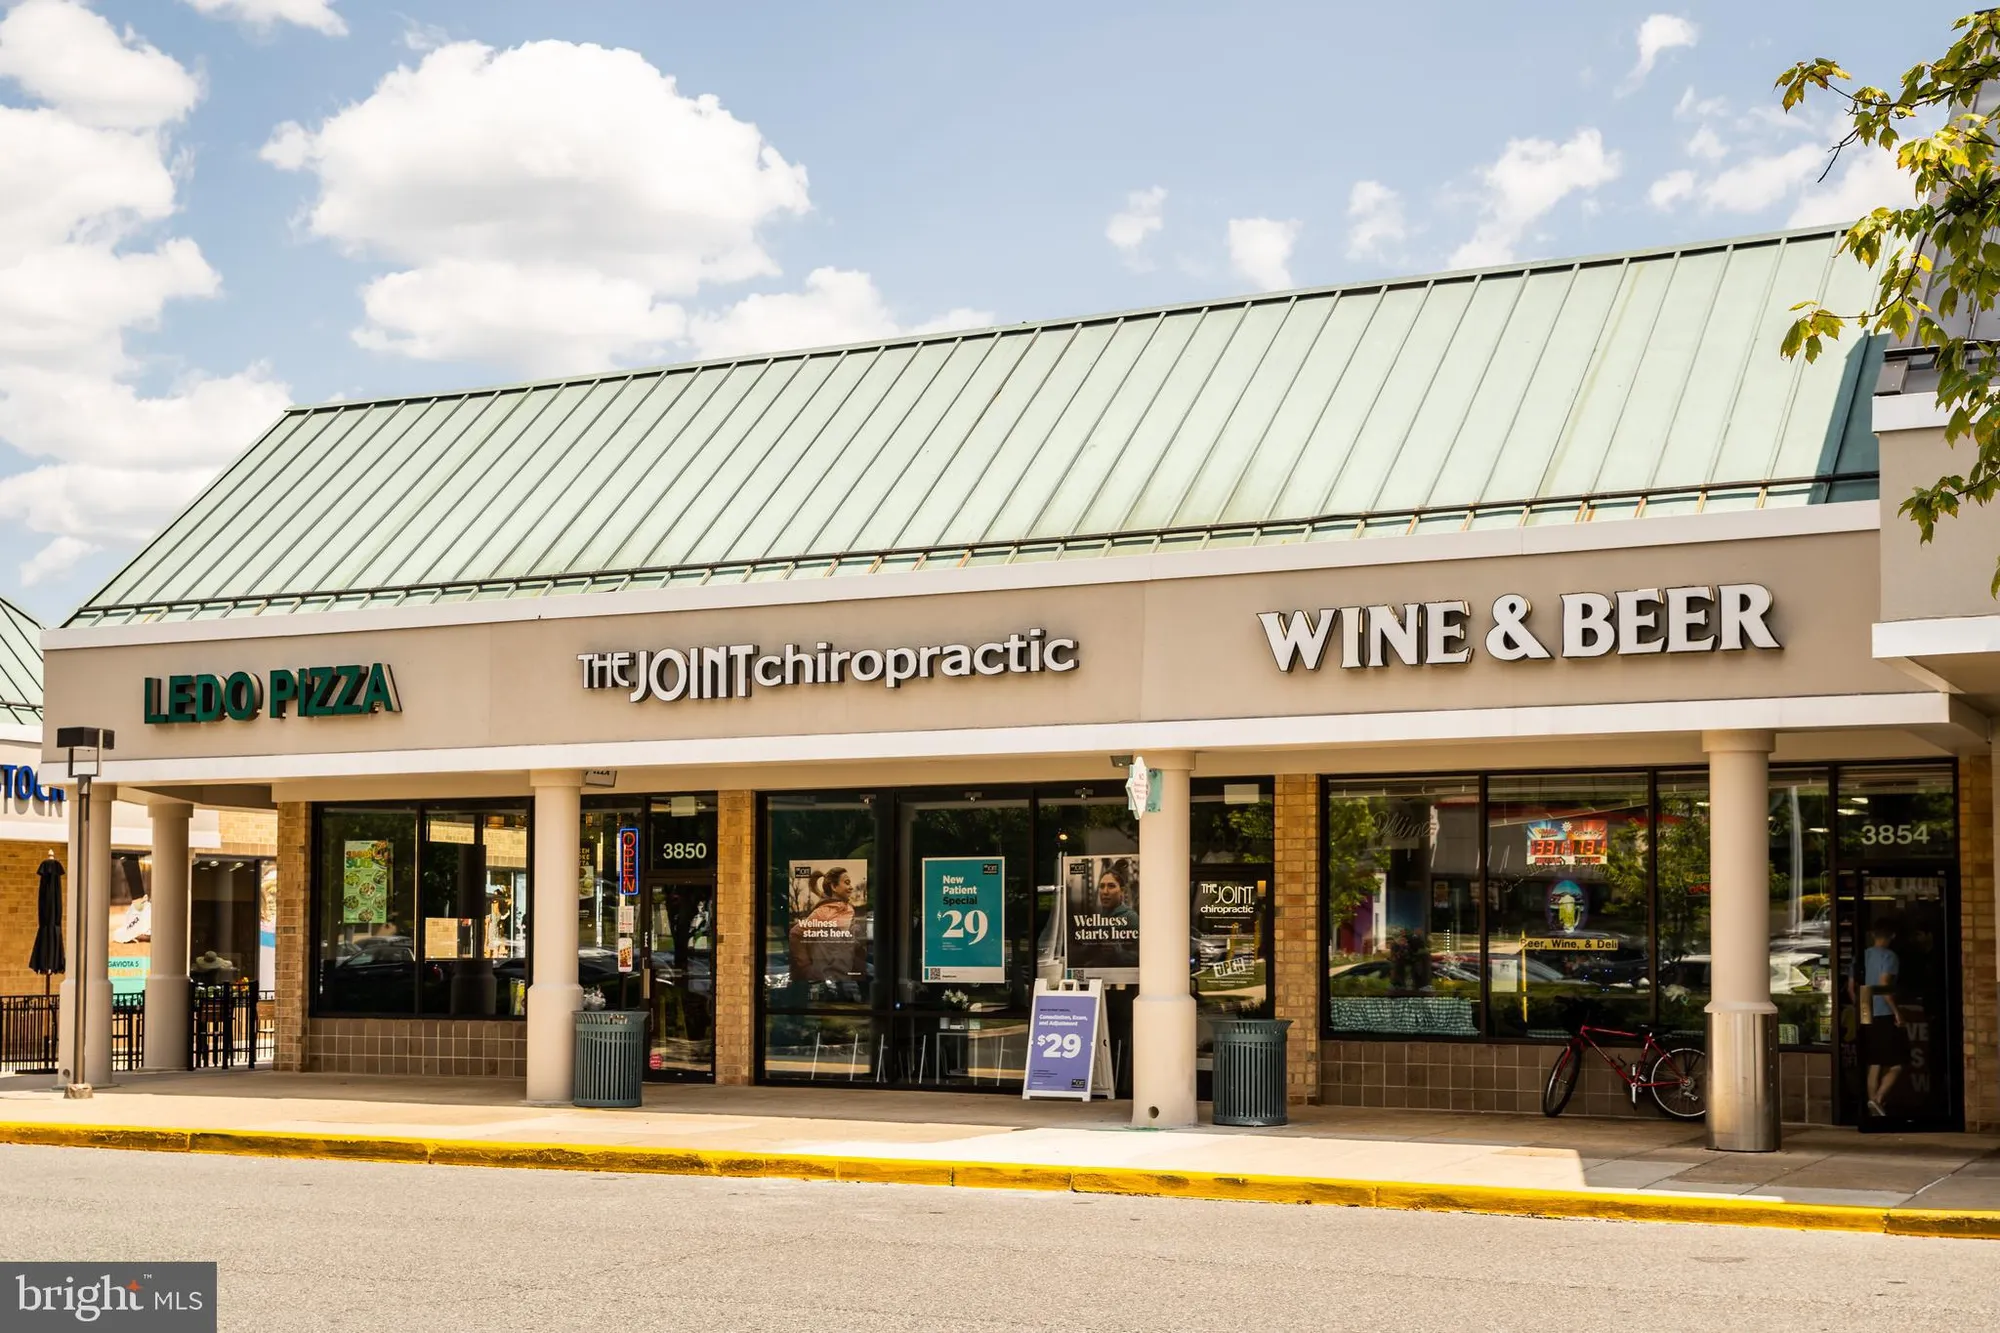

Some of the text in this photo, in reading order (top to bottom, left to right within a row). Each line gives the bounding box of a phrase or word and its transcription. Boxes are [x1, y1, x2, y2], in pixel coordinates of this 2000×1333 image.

[1256, 583, 1784, 673] WINE & BEER
[577, 627, 1080, 703] THE JOINT chiropractic
[144, 662, 402, 725] LEDO PIZZA
[1860, 824, 1931, 845] 3854
[663, 842, 707, 859] 3850
[622, 831, 637, 892] OPEN
[942, 875, 964, 884] New
[942, 885, 978, 895] Patient
[942, 896, 978, 906] Special
[1200, 904, 1255, 914] chiropractic
[799, 919, 838, 928] Wellness
[1073, 913, 1128, 927] Wellness
[803, 928, 853, 938] starts here.
[937, 909, 989, 946] $29
[1074, 928, 1109, 940] starts
[1551, 939, 1581, 949] Wine,
[1584, 940, 1593, 949] &
[1597, 939, 1618, 949] Deli
[1037, 1033, 1082, 1059] $29
